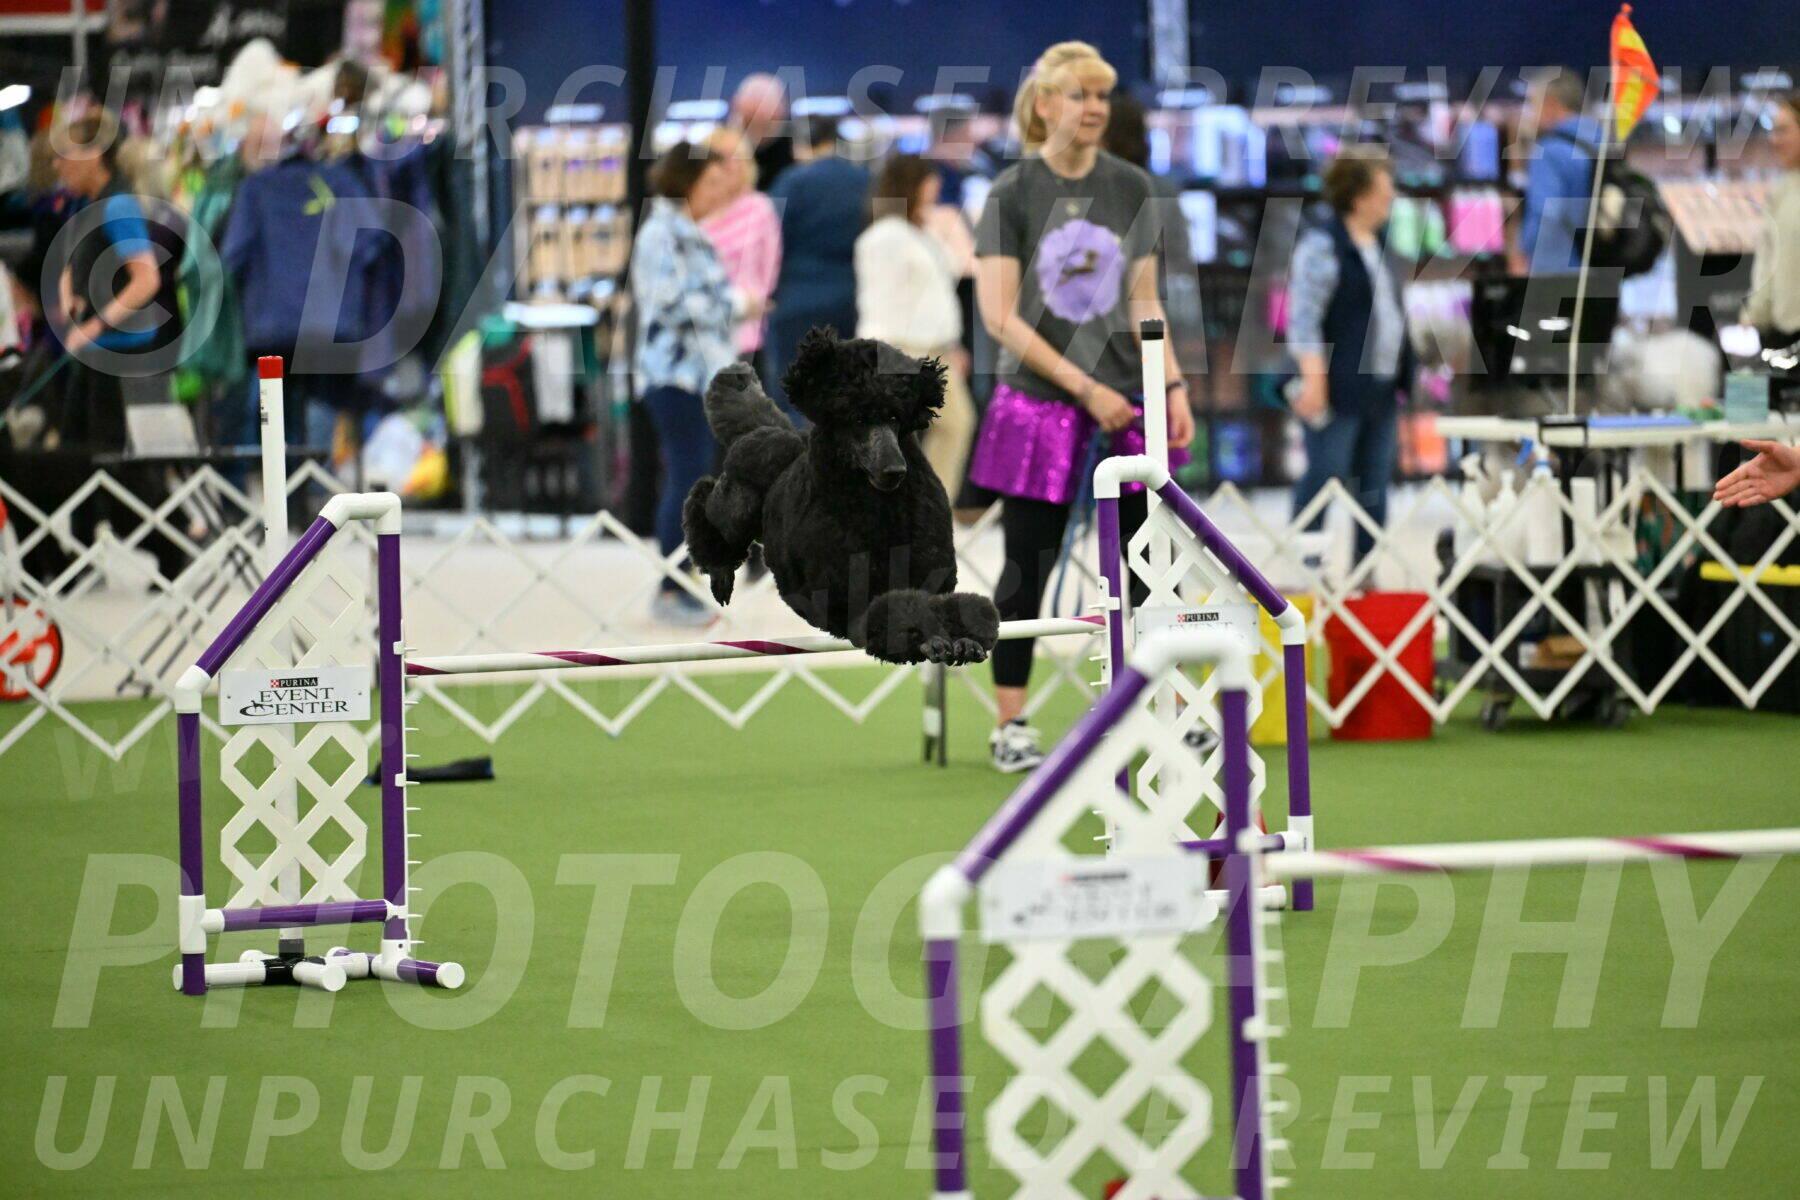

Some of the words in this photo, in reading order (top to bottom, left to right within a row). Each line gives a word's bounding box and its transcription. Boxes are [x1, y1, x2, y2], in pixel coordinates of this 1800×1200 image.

[1185, 612, 1219, 622] PURINA
[279, 677, 318, 687] PURINA
[260, 687, 335, 703] EVENT
[239, 700, 350, 717] CENTER
